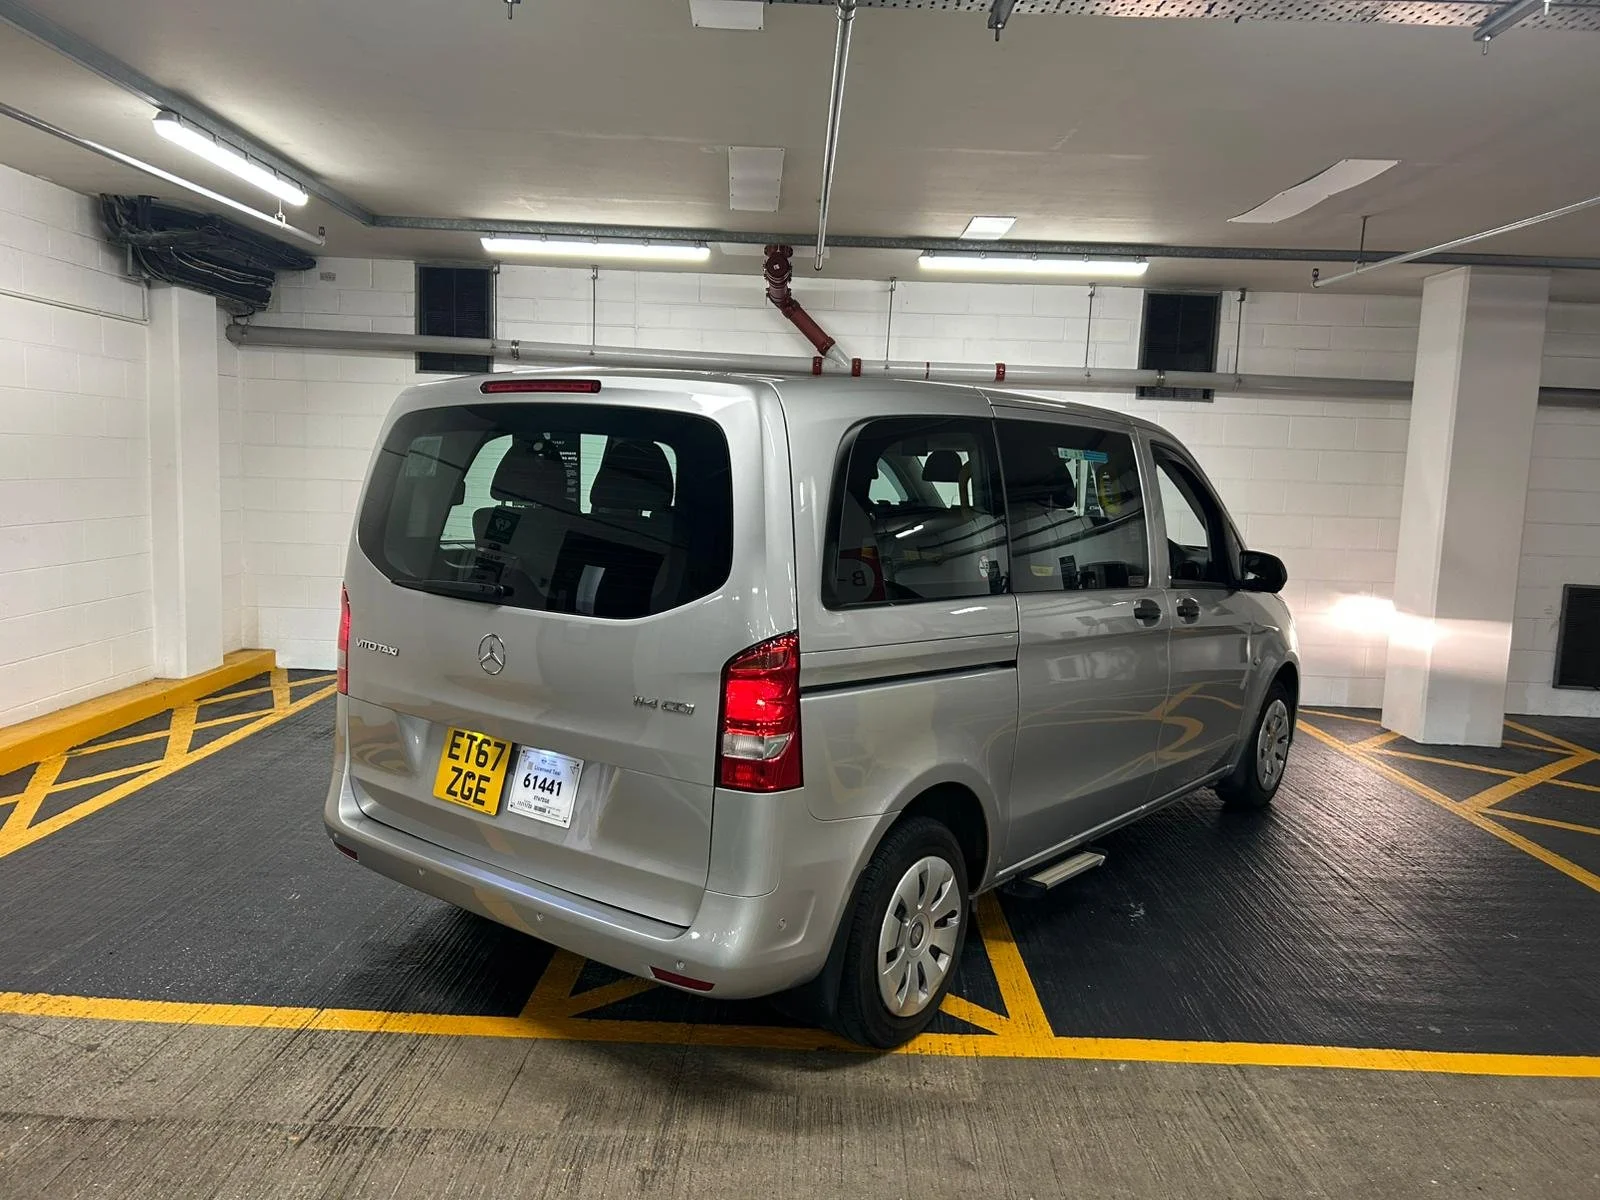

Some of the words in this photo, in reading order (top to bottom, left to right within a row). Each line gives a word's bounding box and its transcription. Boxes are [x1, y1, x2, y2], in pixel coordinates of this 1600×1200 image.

[355, 637, 377, 651] VITO
[377, 643, 399, 656] TAXI
[632, 695, 658, 709] 114
[661, 700, 695, 715] CDI
[448, 730, 507, 772] ET67
[534, 765, 552, 774] Licensed
[446, 766, 491, 806] ZGE
[523, 773, 563, 796] 61441
